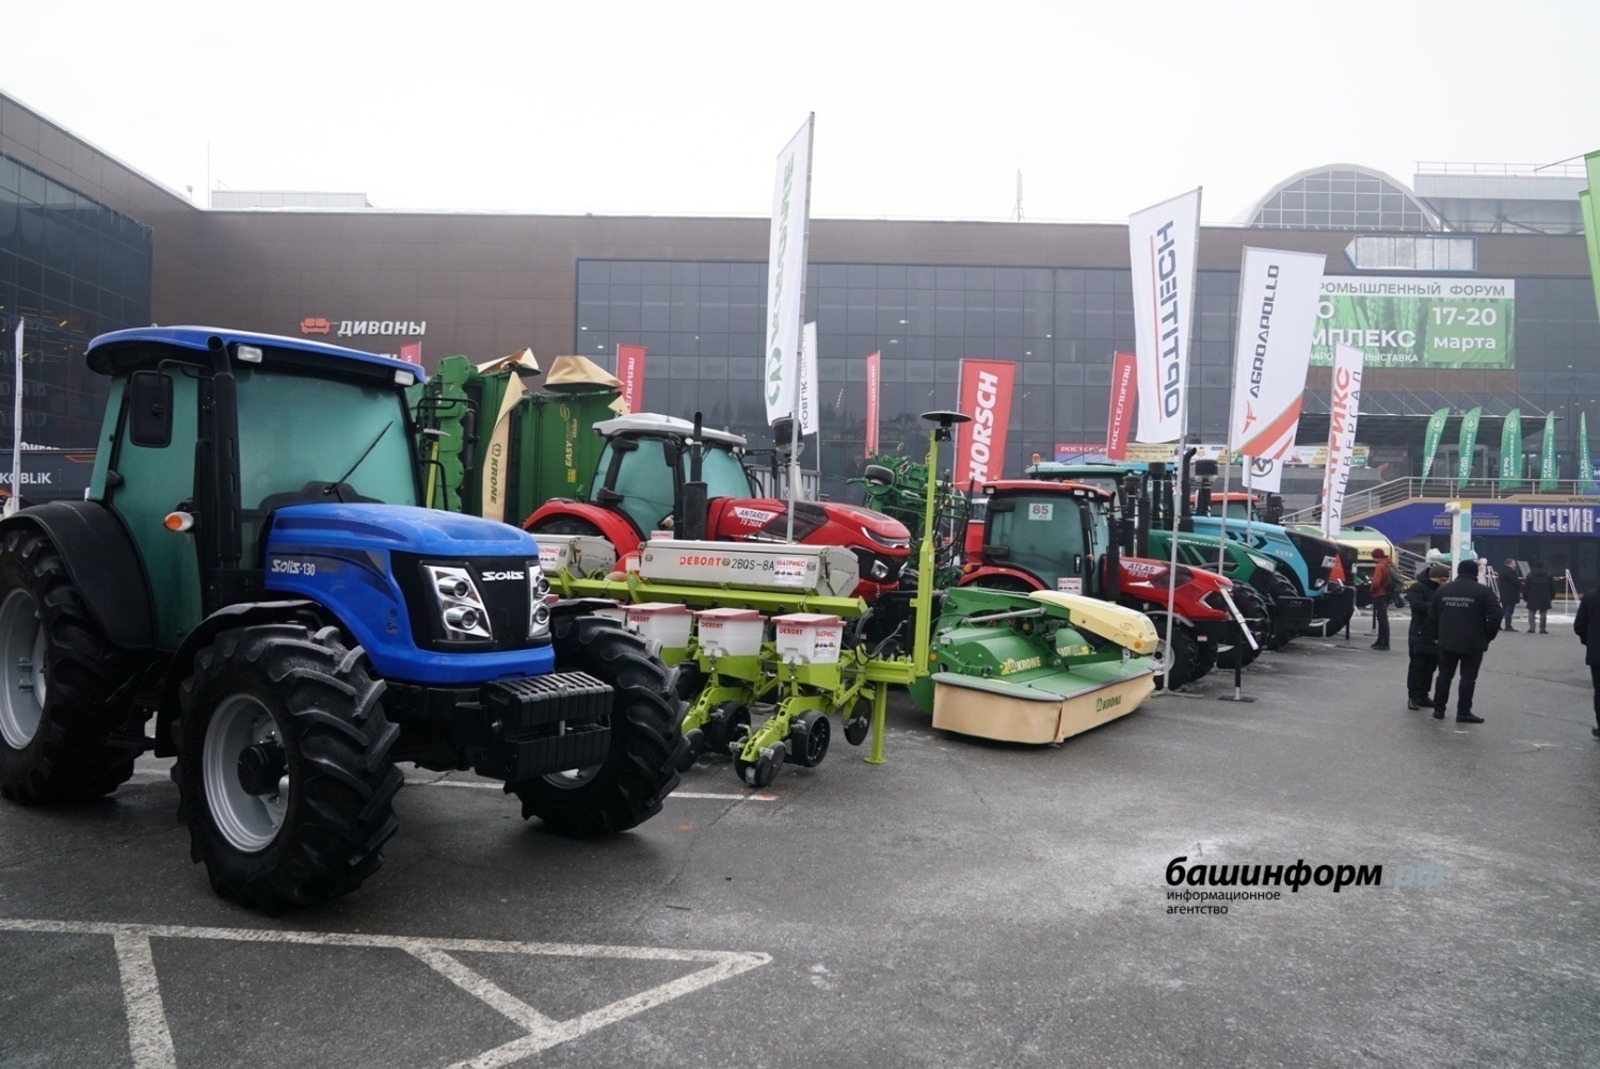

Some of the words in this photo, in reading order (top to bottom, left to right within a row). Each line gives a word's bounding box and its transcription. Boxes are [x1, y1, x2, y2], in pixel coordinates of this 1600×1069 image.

[1450, 284, 1505, 296] ФОРУМ
[1433, 307, 1497, 326] 17-20
[1250, 264, 1280, 398] AGROAPOLLO
[1433, 337, 1496, 352] марта
[1364, 353, 1419, 363] ВЫСТАВКА
[968, 371, 998, 484] HORSCH
[1331, 371, 1361, 519] УНИВЕРСАЛ
[490, 457, 499, 505] KRONE
[739, 509, 770, 521] ANTARES
[1032, 505, 1049, 515] 85
[1521, 507, 1594, 533] РОССИЯ
[679, 556, 721, 567] DEBONT
[731, 559, 775, 571] 2BQS-8A
[776, 559, 806, 568] МАТРИКС
[1128, 563, 1156, 573] ATLAS
[1016, 656, 1041, 670] KRONE
[1102, 695, 1122, 710] KRONE
